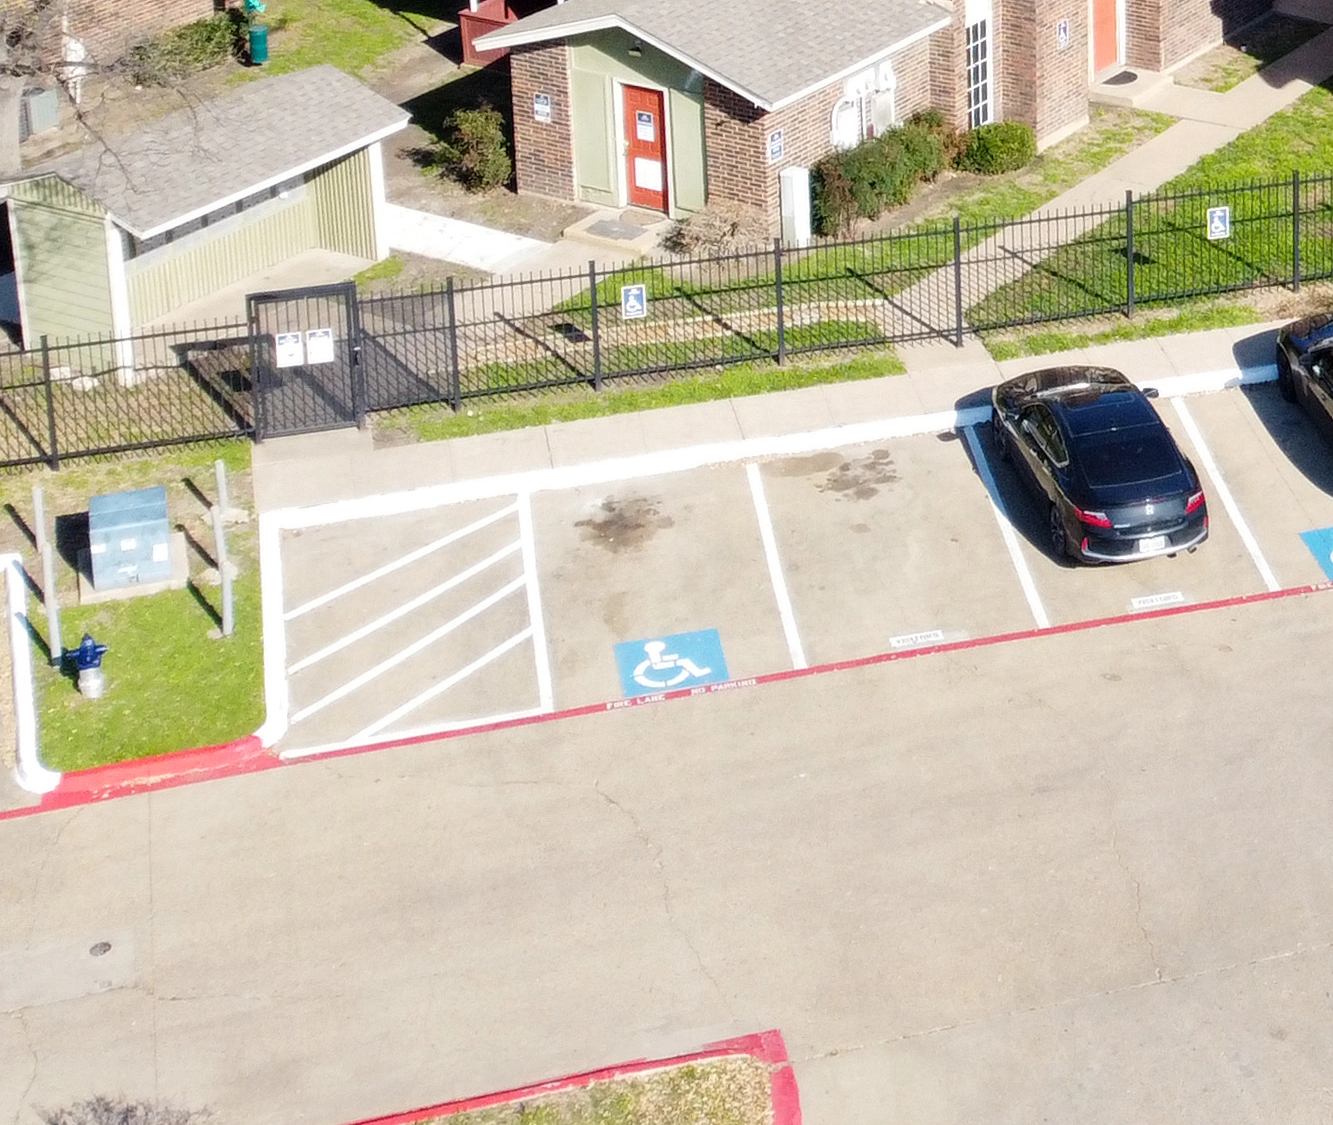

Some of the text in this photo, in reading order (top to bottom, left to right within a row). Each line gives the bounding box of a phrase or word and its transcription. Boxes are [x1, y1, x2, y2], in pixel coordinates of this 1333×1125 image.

[605, 679, 758, 710] FIRE LANE NO PARKING
